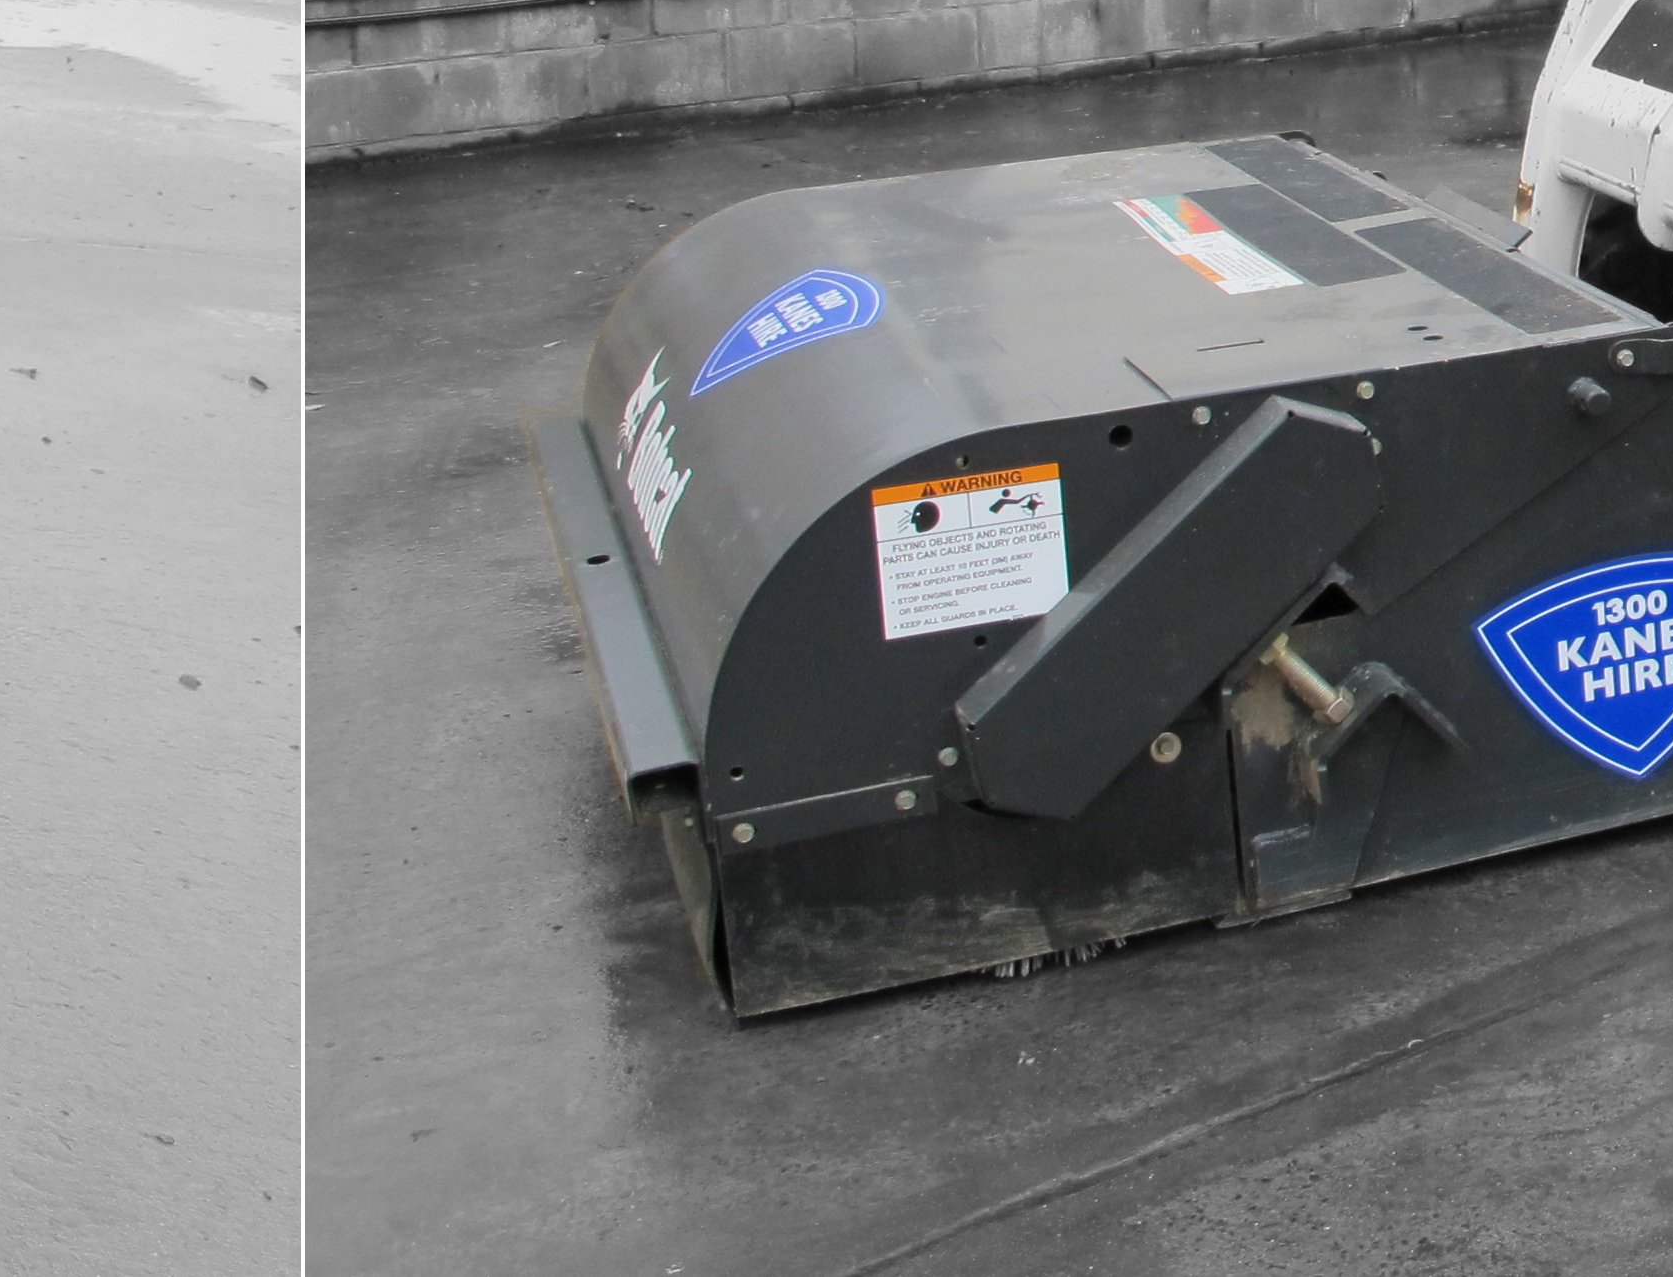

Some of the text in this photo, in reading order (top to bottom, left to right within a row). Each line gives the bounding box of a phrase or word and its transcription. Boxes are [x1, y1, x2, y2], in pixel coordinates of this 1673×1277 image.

[774, 292, 825, 333] KANES
[747, 312, 788, 348] HIRE
[941, 470, 1022, 493] WARNING
[883, 530, 1060, 565] PARTS CAN CAUSE INJURY OR DEATH
[892, 522, 1047, 553] FLYING OBJECTS AND ROTATING
[895, 571, 915, 580] STAY
[929, 564, 955, 575] LEAST
[969, 559, 989, 568] FEET
[1010, 552, 1033, 562] AWAY
[897, 581, 921, 591] FROM
[924, 573, 971, 587] OPERATING
[898, 596, 920, 605] STOP
[922, 591, 953, 601] ENGINE
[955, 584, 988, 596] BEFORE
[899, 607, 911, 615] OR
[924, 616, 939, 625] ALL
[941, 609, 976, 622] GUARDS
[978, 608, 987, 616] IN
[1591, 590, 1668, 626] 1300
